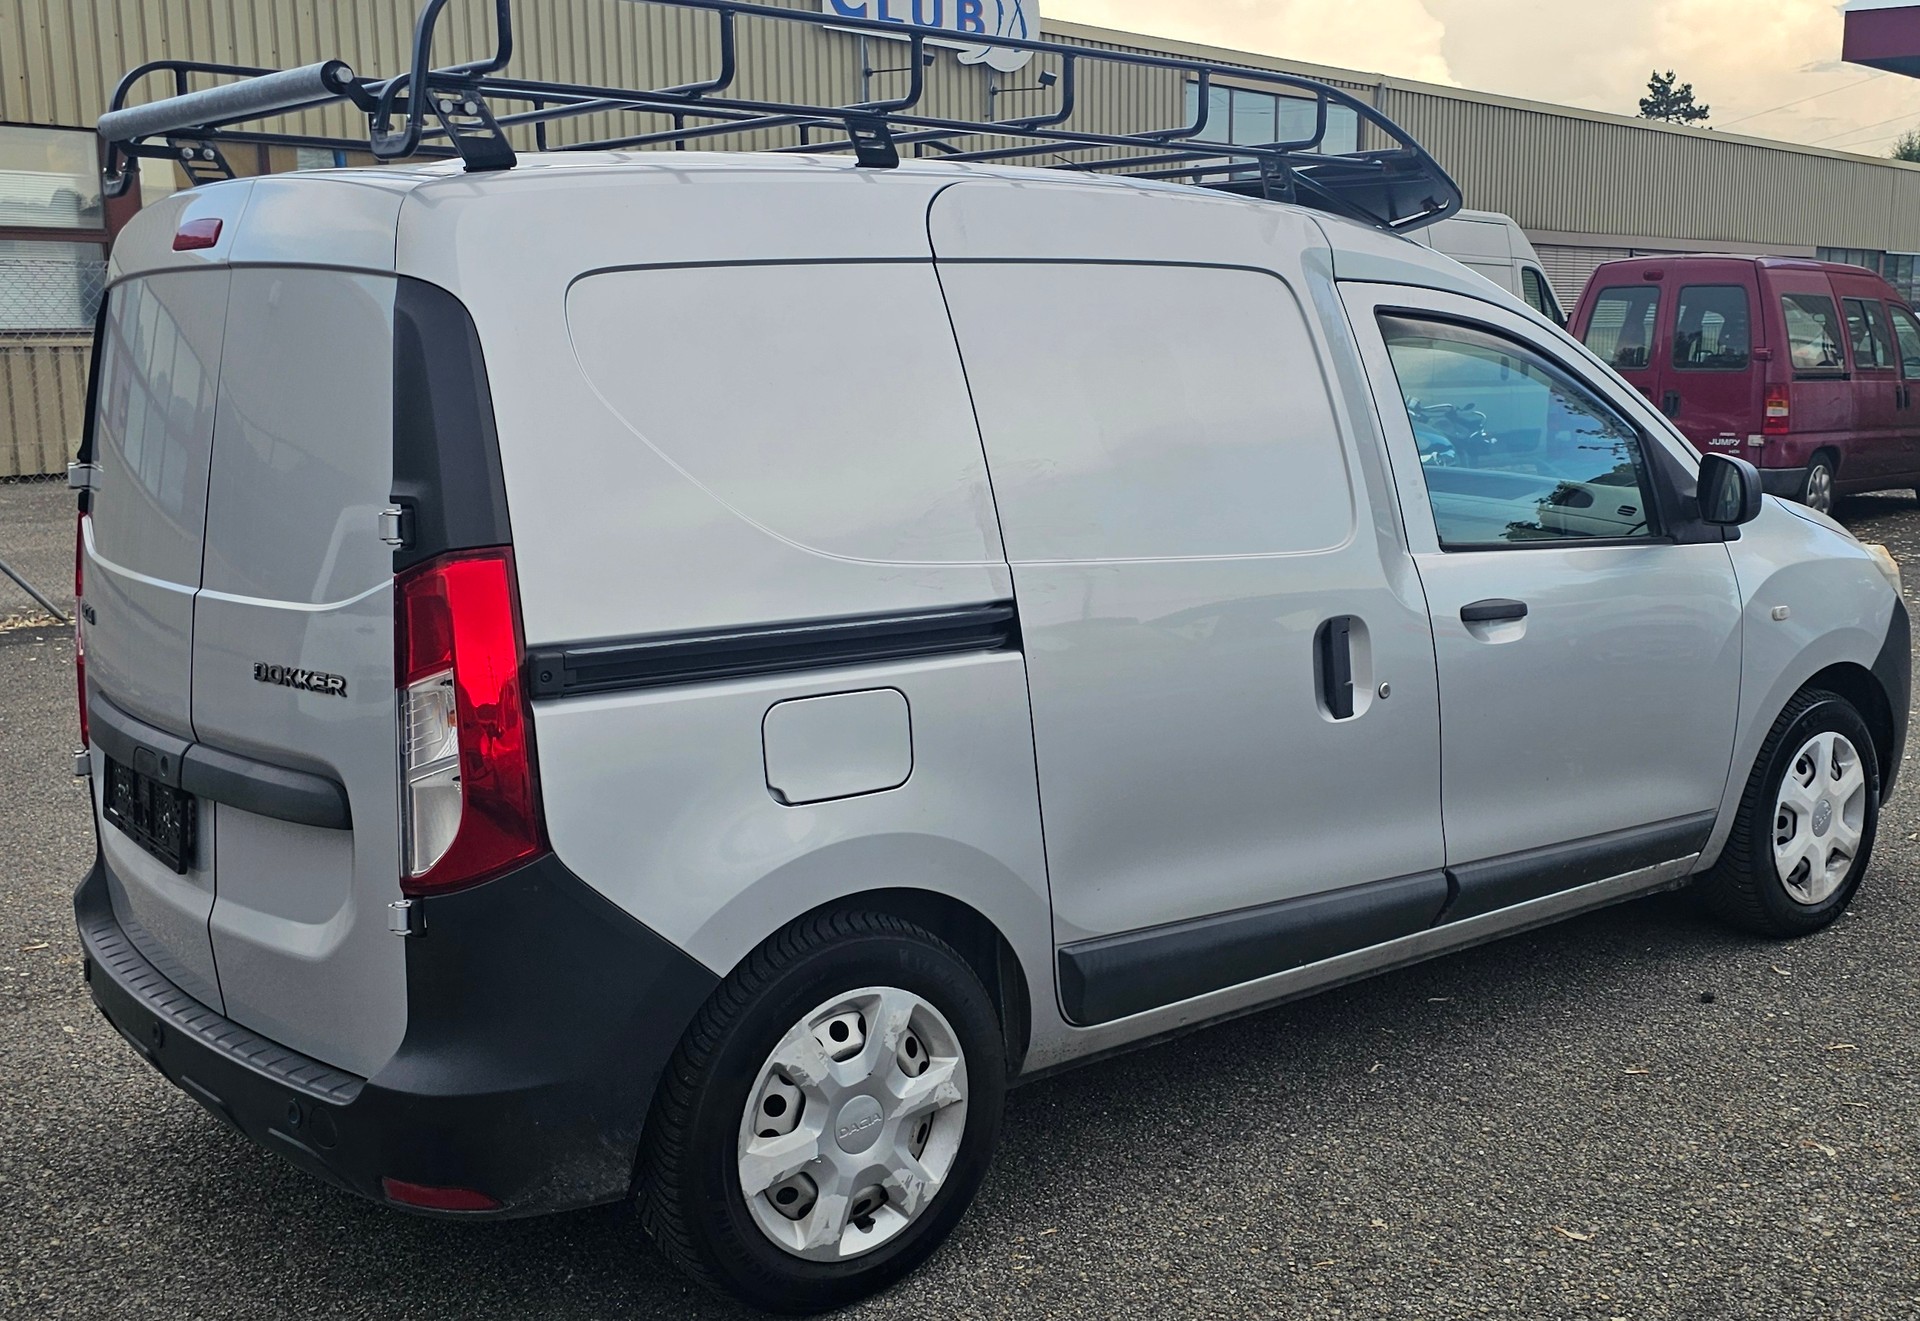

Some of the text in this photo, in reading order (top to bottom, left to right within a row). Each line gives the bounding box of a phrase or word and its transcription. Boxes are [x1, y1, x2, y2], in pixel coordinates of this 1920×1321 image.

[830, 0, 985, 34] CLUB
[1708, 438, 1741, 446] JUMPY
[253, 662, 347, 697] DOKKER
[839, 1113, 882, 1138] DACIA
